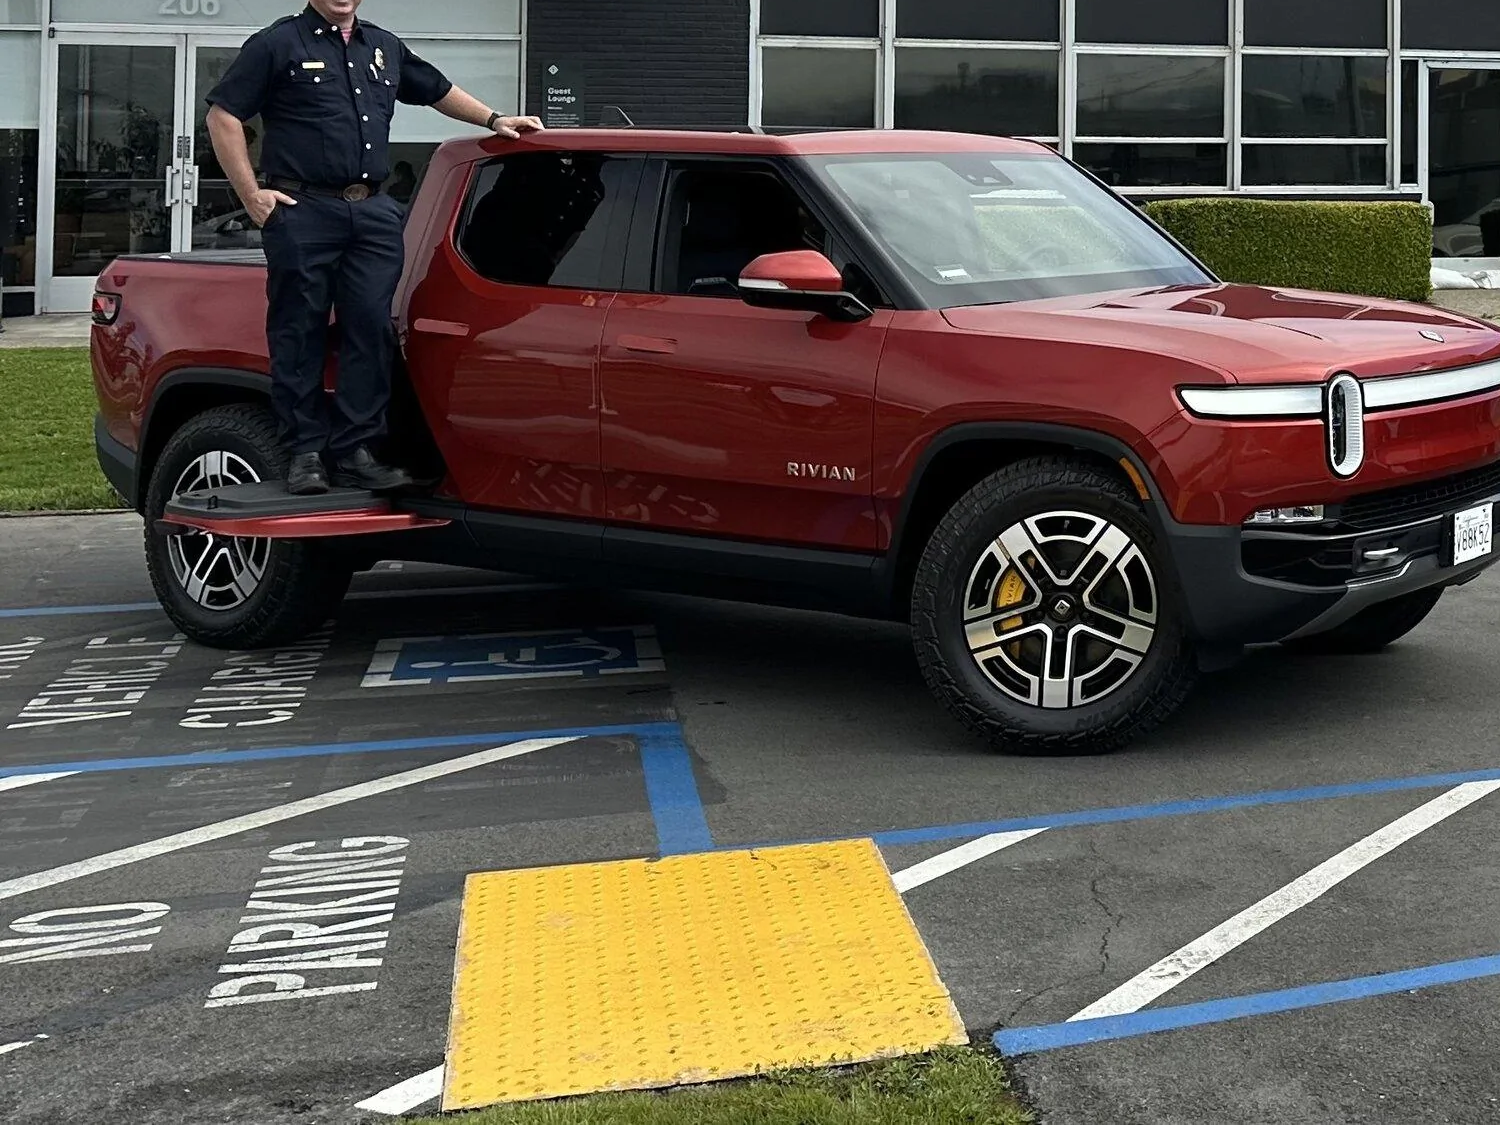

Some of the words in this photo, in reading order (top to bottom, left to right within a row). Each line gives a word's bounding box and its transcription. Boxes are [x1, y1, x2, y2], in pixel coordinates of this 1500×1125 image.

[547, 87, 571, 95] Guest
[547, 95, 576, 104] Lounge
[786, 461, 856, 481] RIVIAN
[1456, 522, 1490, 553] V88K52
[7, 633, 188, 730] VEHICLE
[179, 620, 336, 728] CHARGI
[0, 902, 171, 965] NO
[204, 835, 411, 1009] PARKING
